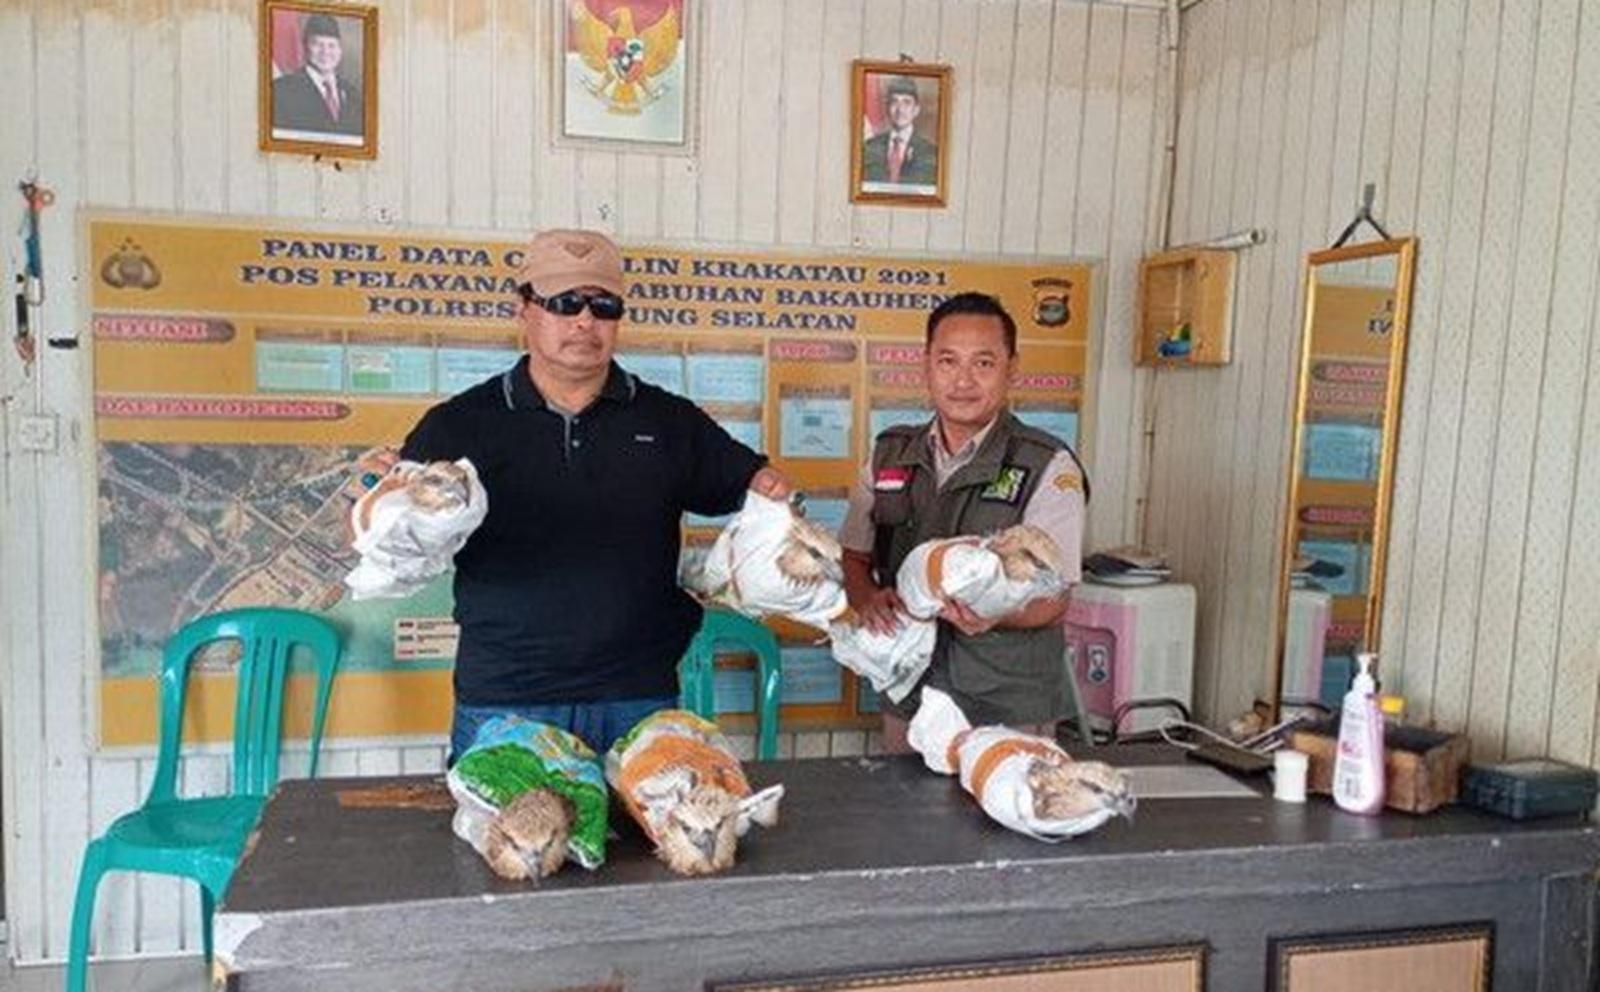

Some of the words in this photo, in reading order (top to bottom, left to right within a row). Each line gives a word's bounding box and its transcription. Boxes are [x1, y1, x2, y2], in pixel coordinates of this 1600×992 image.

[262, 239, 387, 262] PANEL
[400, 246, 492, 268] DATA
[622, 257, 679, 275] LIN
[692, 260, 867, 284] KRAKATAU
[878, 267, 948, 285] 2021
[241, 265, 318, 286] POS
[332, 269, 519, 294] PELAYANA
[627, 282, 763, 304] ABUHAN
[776, 289, 950, 311] BAKAUHEN
[367, 296, 516, 318] POLRES
[711, 308, 857, 330] SELATAN
